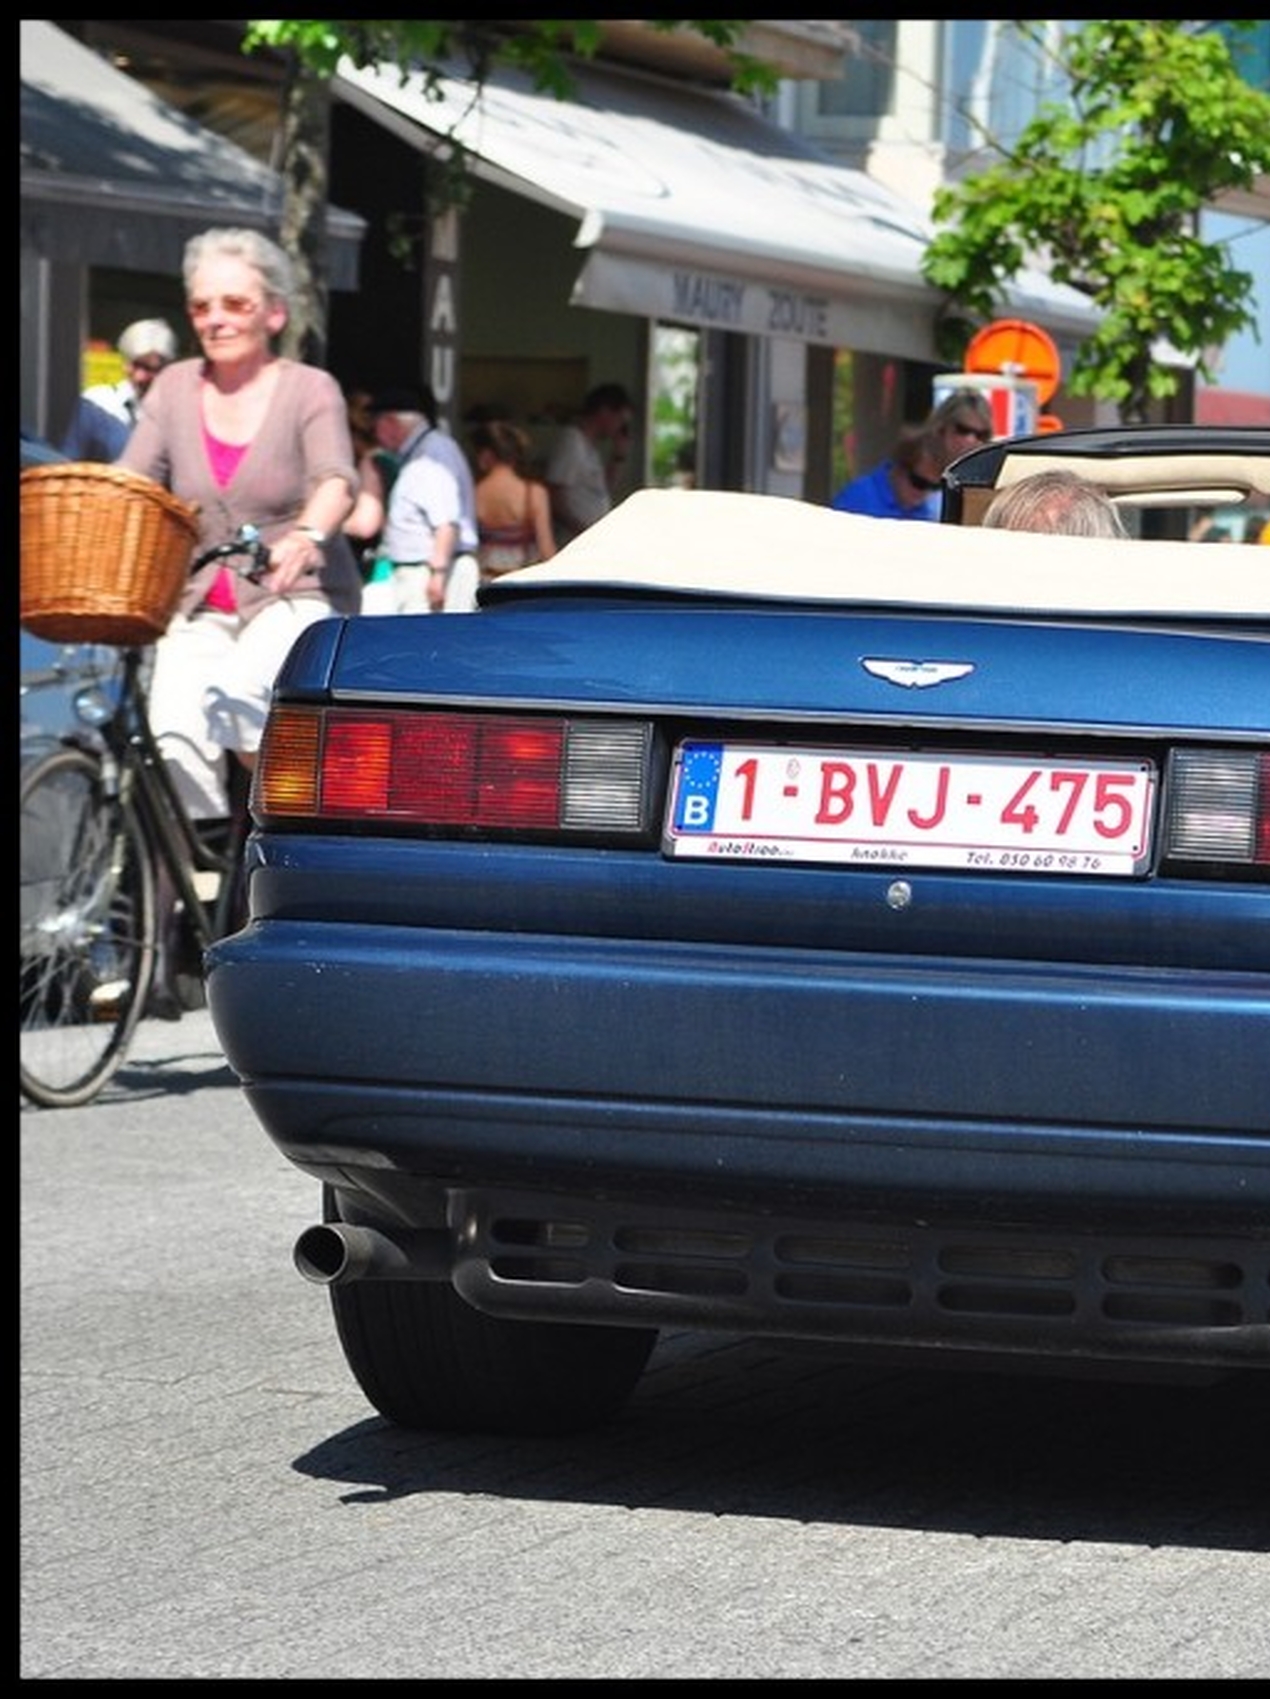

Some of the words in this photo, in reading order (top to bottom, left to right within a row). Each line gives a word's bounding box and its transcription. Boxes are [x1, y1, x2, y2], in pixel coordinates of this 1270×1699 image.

[673, 271, 747, 323] MAURY
[768, 288, 829, 338] ZOUTE
[684, 797, 709, 825] B
[735, 757, 1136, 839] 1-BVJ-475
[966, 852, 993, 864] Tel.
[999, 853, 1030, 866] 050
[1033, 855, 1054, 867] 60
[1059, 855, 1077, 868] 98
[1083, 857, 1102, 870] 76
